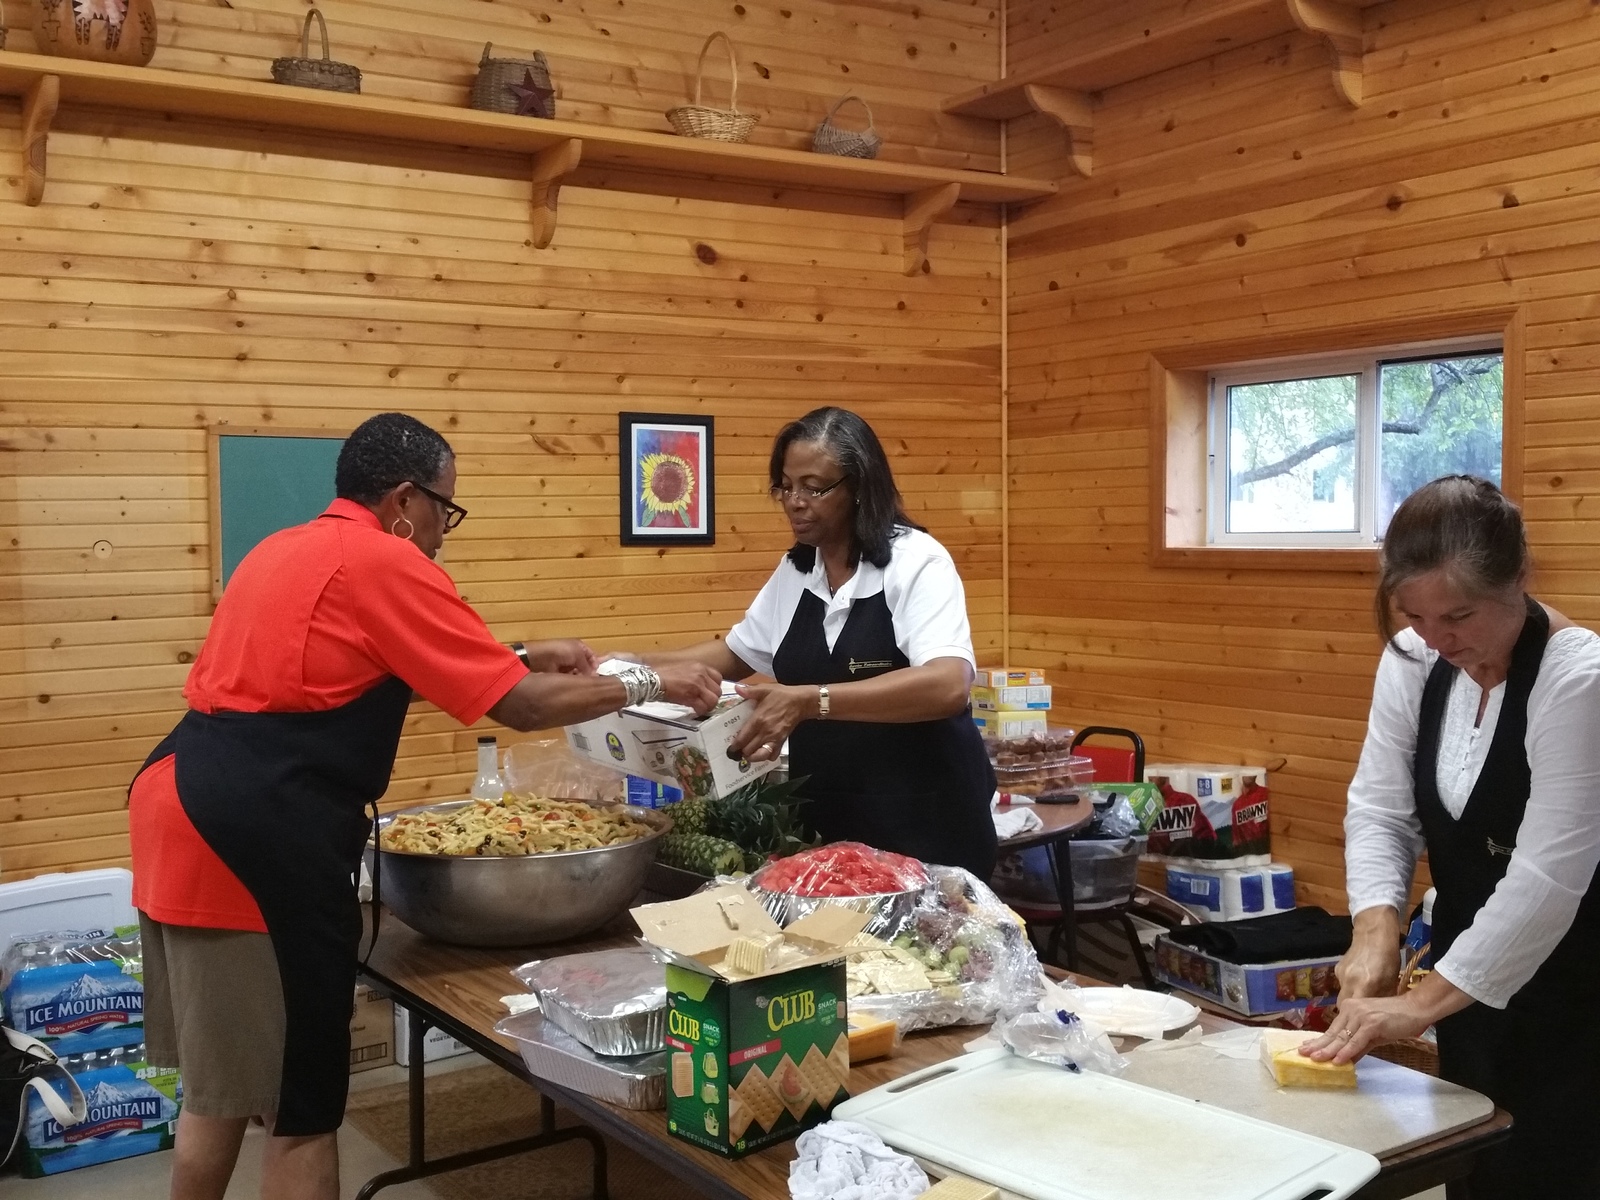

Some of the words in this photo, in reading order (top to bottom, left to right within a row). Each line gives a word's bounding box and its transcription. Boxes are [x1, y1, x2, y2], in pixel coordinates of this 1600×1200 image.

[725, 770, 755, 790] Foodservice
[1237, 801, 1268, 824] BRAWNY
[30, 1006, 54, 1025] ICE
[58, 995, 142, 1018] MOUNTAIN
[767, 989, 816, 1032] CLUB
[818, 997, 837, 1010] SNACK
[48, 1024, 65, 1033] 100%
[67, 1020, 90, 1030] NATURAL
[90, 1014, 108, 1023] SPRING
[109, 1013, 125, 1021] WATER
[669, 1009, 700, 1041] CLUB
[743, 1045, 768, 1060] ORIGINAL
[136, 1066, 157, 1080] 48
[669, 1119, 677, 1131] 18
[736, 1140, 746, 1150] 18
